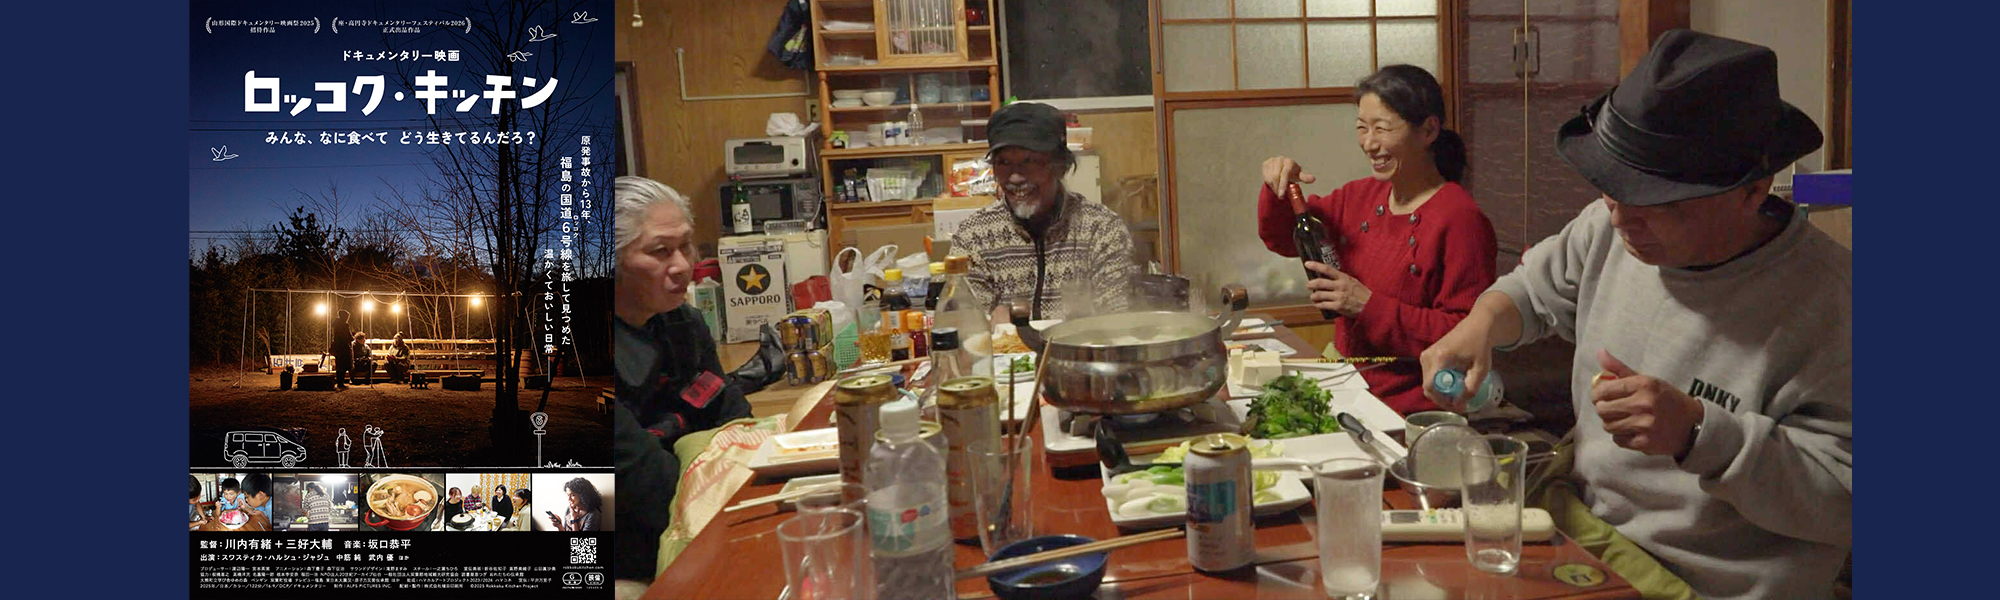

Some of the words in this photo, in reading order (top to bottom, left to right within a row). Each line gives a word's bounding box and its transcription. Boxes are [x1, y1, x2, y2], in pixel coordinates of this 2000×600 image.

[342, 50, 460, 62] ドキュメンタリー映画
[244, 70, 559, 117] ロッコク・キッチン
[265, 131, 388, 146] みんな、なに食べて
[398, 131, 536, 146] どう生きてるんだろ？
[580, 135, 592, 224] 原発事故から13年、
[560, 156, 572, 346] 福島の国道6号線を旅して見つめた
[544, 248, 554, 354] 温かくておいしい日常
[730, 294, 780, 307] SAPPORO
